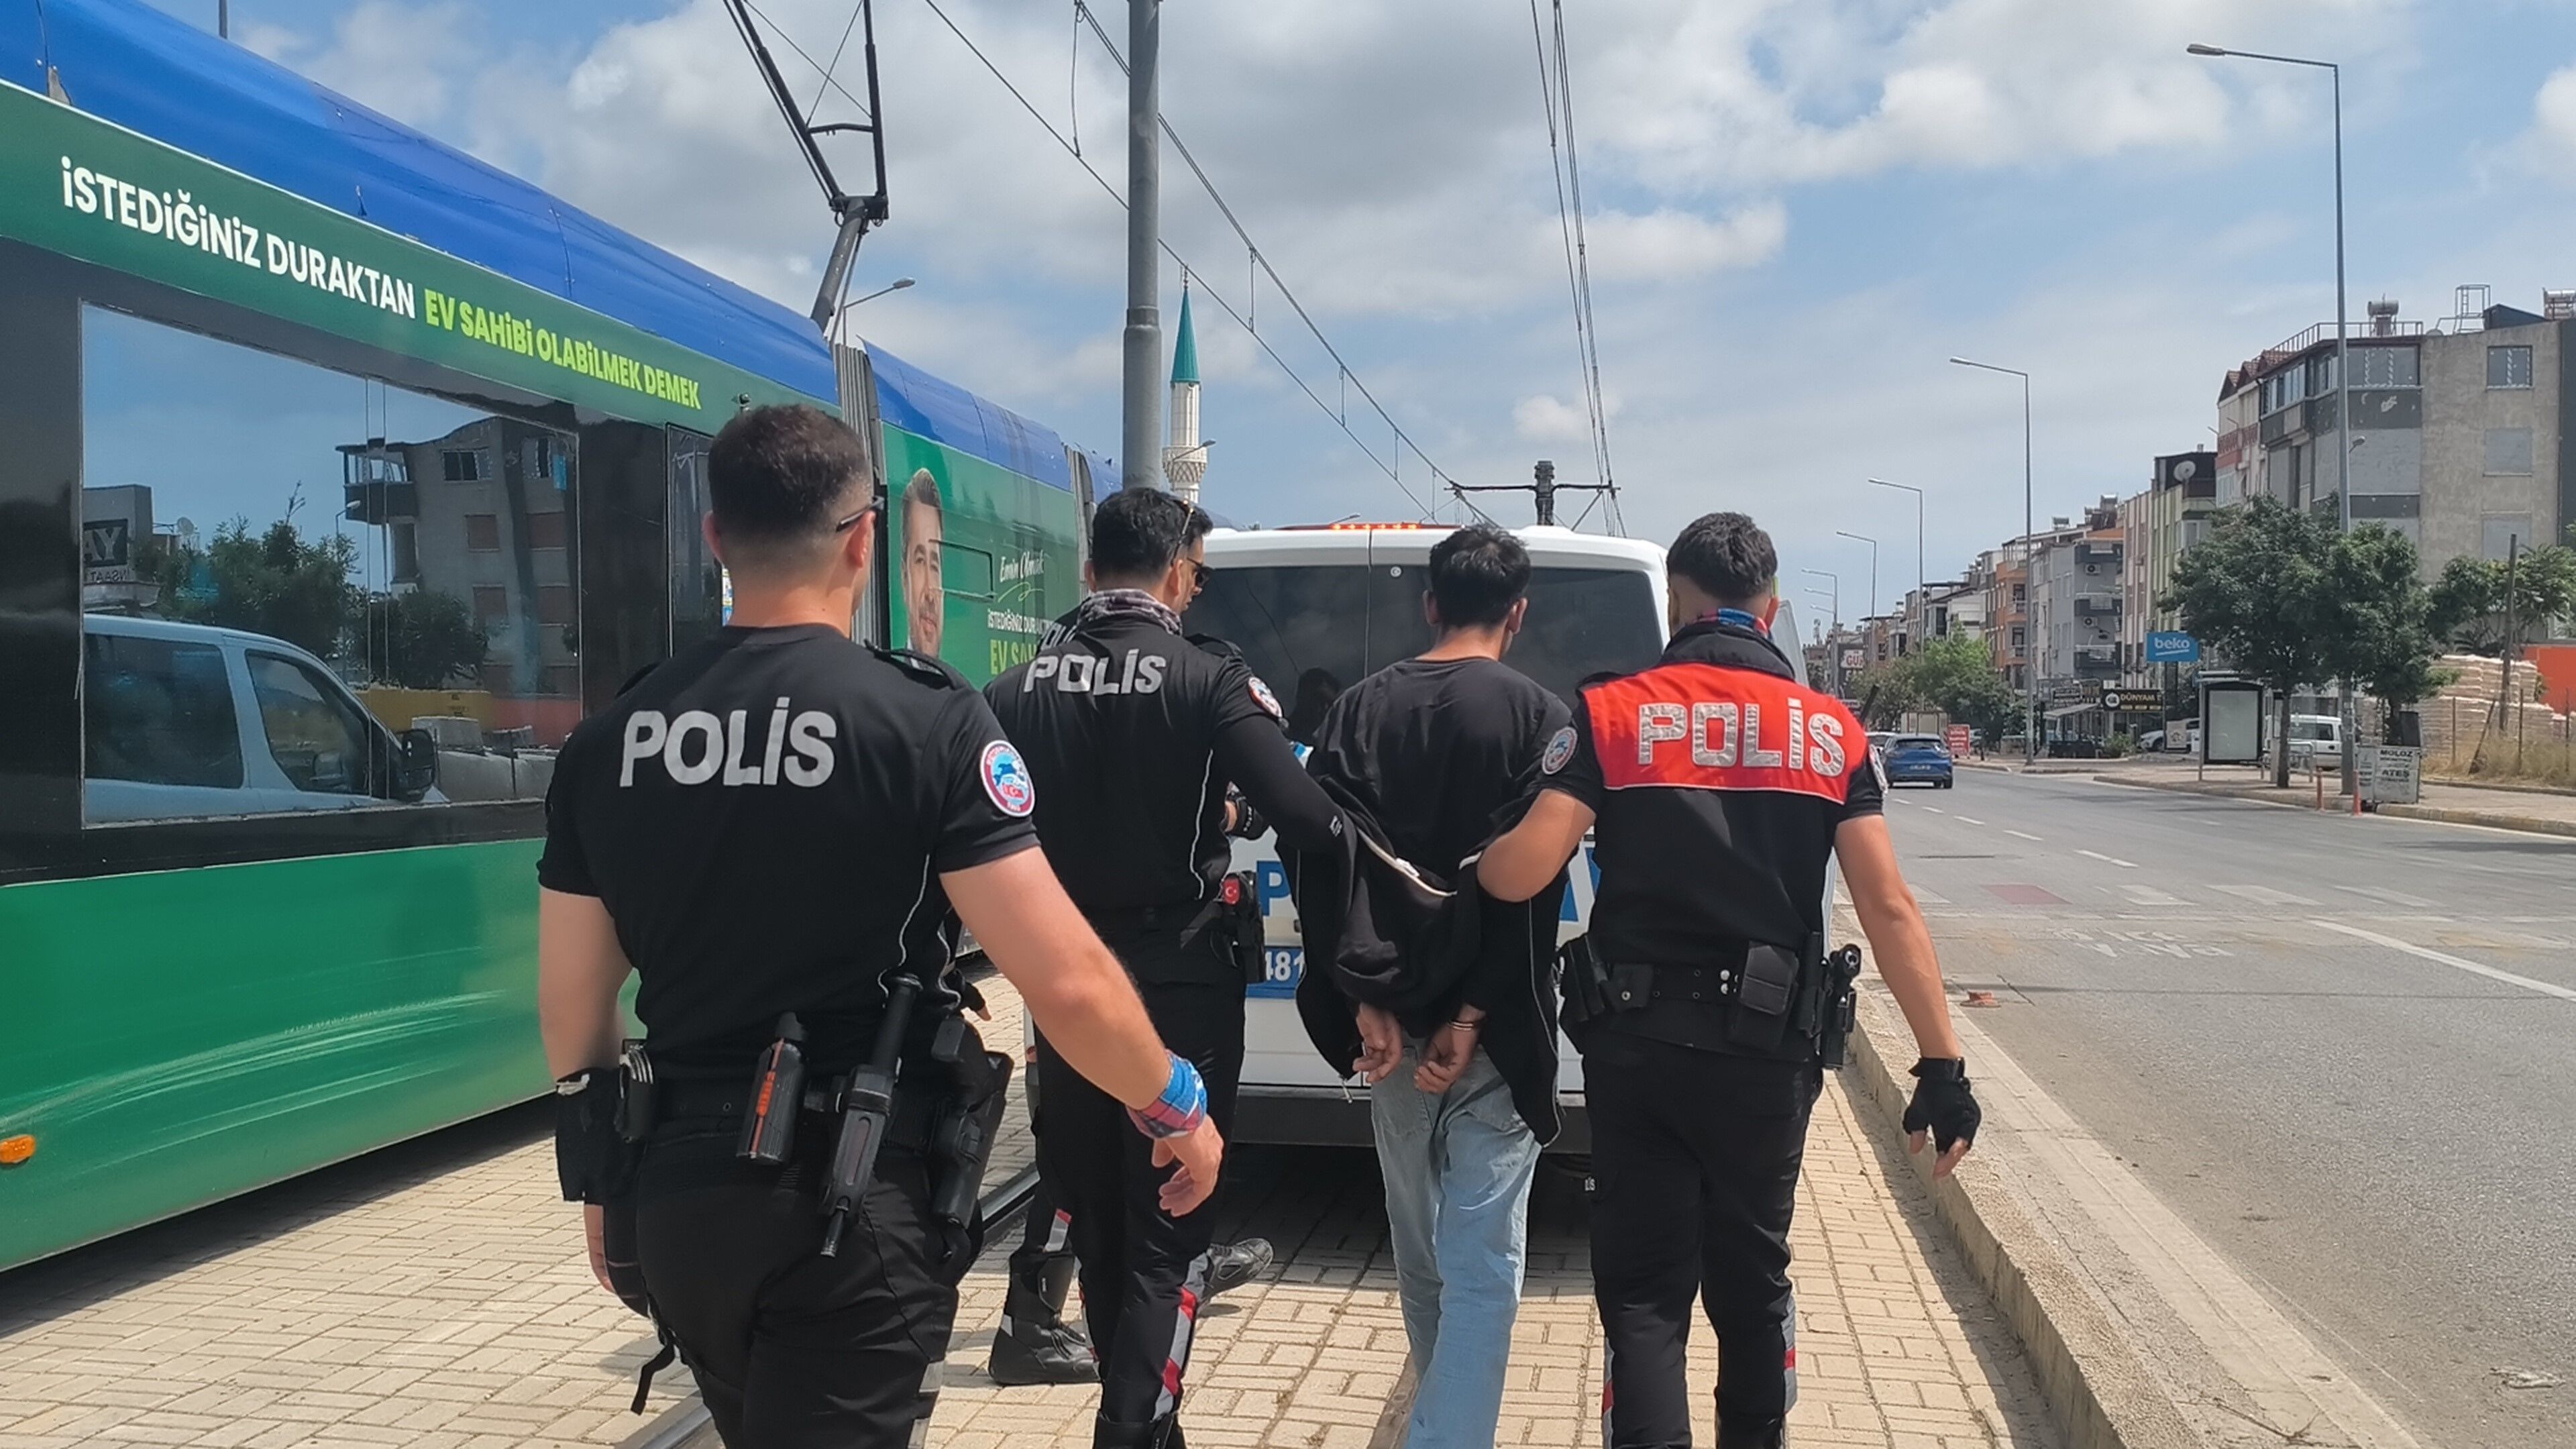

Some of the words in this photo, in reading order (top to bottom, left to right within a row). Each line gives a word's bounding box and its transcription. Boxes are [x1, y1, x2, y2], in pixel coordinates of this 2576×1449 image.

[61, 156, 261, 269] İSTEDİĞİNİZ
[266, 233, 416, 319] DURAKTAN
[424, 288, 455, 331] EV
[460, 301, 533, 357] SAHİBİ
[537, 328, 643, 392] OLABİLMEK
[643, 366, 702, 410] DEMEK
[990, 639, 1008, 676] EV
[2154, 637, 2190, 649] beko
[1023, 648, 1167, 696] POLİS
[620, 696, 837, 788] POLİS
[1638, 697, 1845, 777] POLİS
[2380, 749, 2413, 757] MOLOZ
